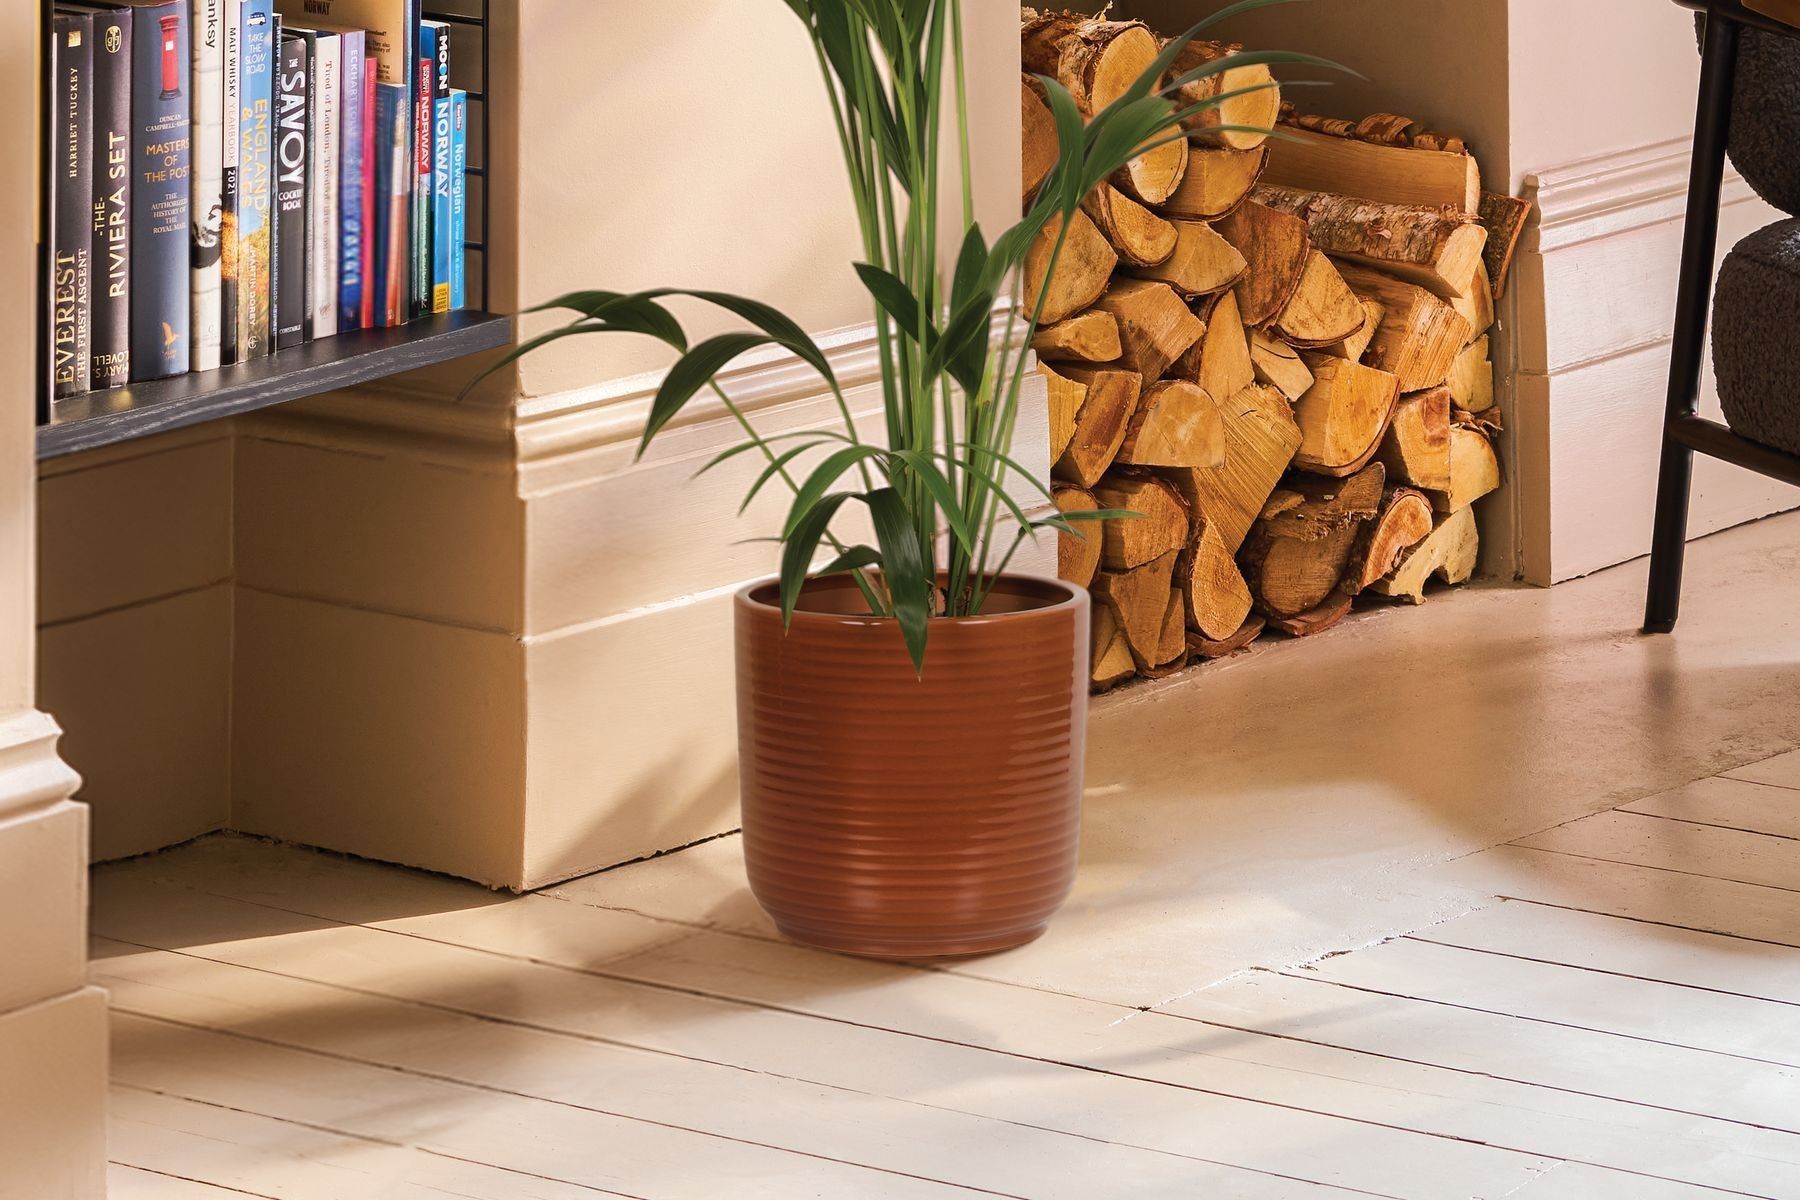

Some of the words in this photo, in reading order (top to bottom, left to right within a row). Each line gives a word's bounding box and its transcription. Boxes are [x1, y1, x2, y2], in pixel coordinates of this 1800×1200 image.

[303, 0, 331, 16] NORWAY
[229, 27, 237, 55] MALT
[247, 32, 265, 44] TAKE
[249, 42, 262, 53] THE
[245, 52, 267, 65] SLOW
[245, 63, 266, 76] ROAD
[438, 34, 448, 90] MOON
[228, 57, 237, 98] WHISKY
[324, 60, 333, 90] Tired
[349, 49, 359, 103] ECKHART
[69, 66, 79, 119] TUCKEY
[323, 93, 333, 105] of
[159, 113, 182, 123] DUNCAN
[241, 106, 253, 121] &
[279, 70, 306, 185] SAVOY
[227, 102, 236, 163] YEARBOOK
[322, 108, 332, 153] London,
[421, 96, 431, 169] NORWAY
[68, 121, 78, 178] HARRIET
[109, 131, 126, 180] SET
[146, 138, 190, 155] MASTERS
[163, 155, 178, 167] OF
[254, 98, 269, 211] ENGLAND
[437, 101, 449, 198] NORWAY
[144, 170, 167, 183] THE
[169, 165, 190, 180] POST
[226, 169, 236, 196] 2021
[240, 128, 253, 209] WALES
[452, 143, 464, 215] Norwegian
[164, 192, 178, 200] THE
[152, 207, 180, 218] HISTORY
[165, 217, 177, 225] THE
[109, 185, 126, 298] RIVIERA
[153, 224, 173, 234] ROYAL
[77, 248, 88, 304] ASCENT
[248, 248, 257, 289] MARTIN
[55, 249, 76, 385] EVEREST
[248, 290, 256, 326] DOREY
[77, 307, 87, 348] FIRST
[77, 351, 87, 382] THE
[93, 350, 129, 366] LOVELL
[103, 358, 129, 377] MARY
